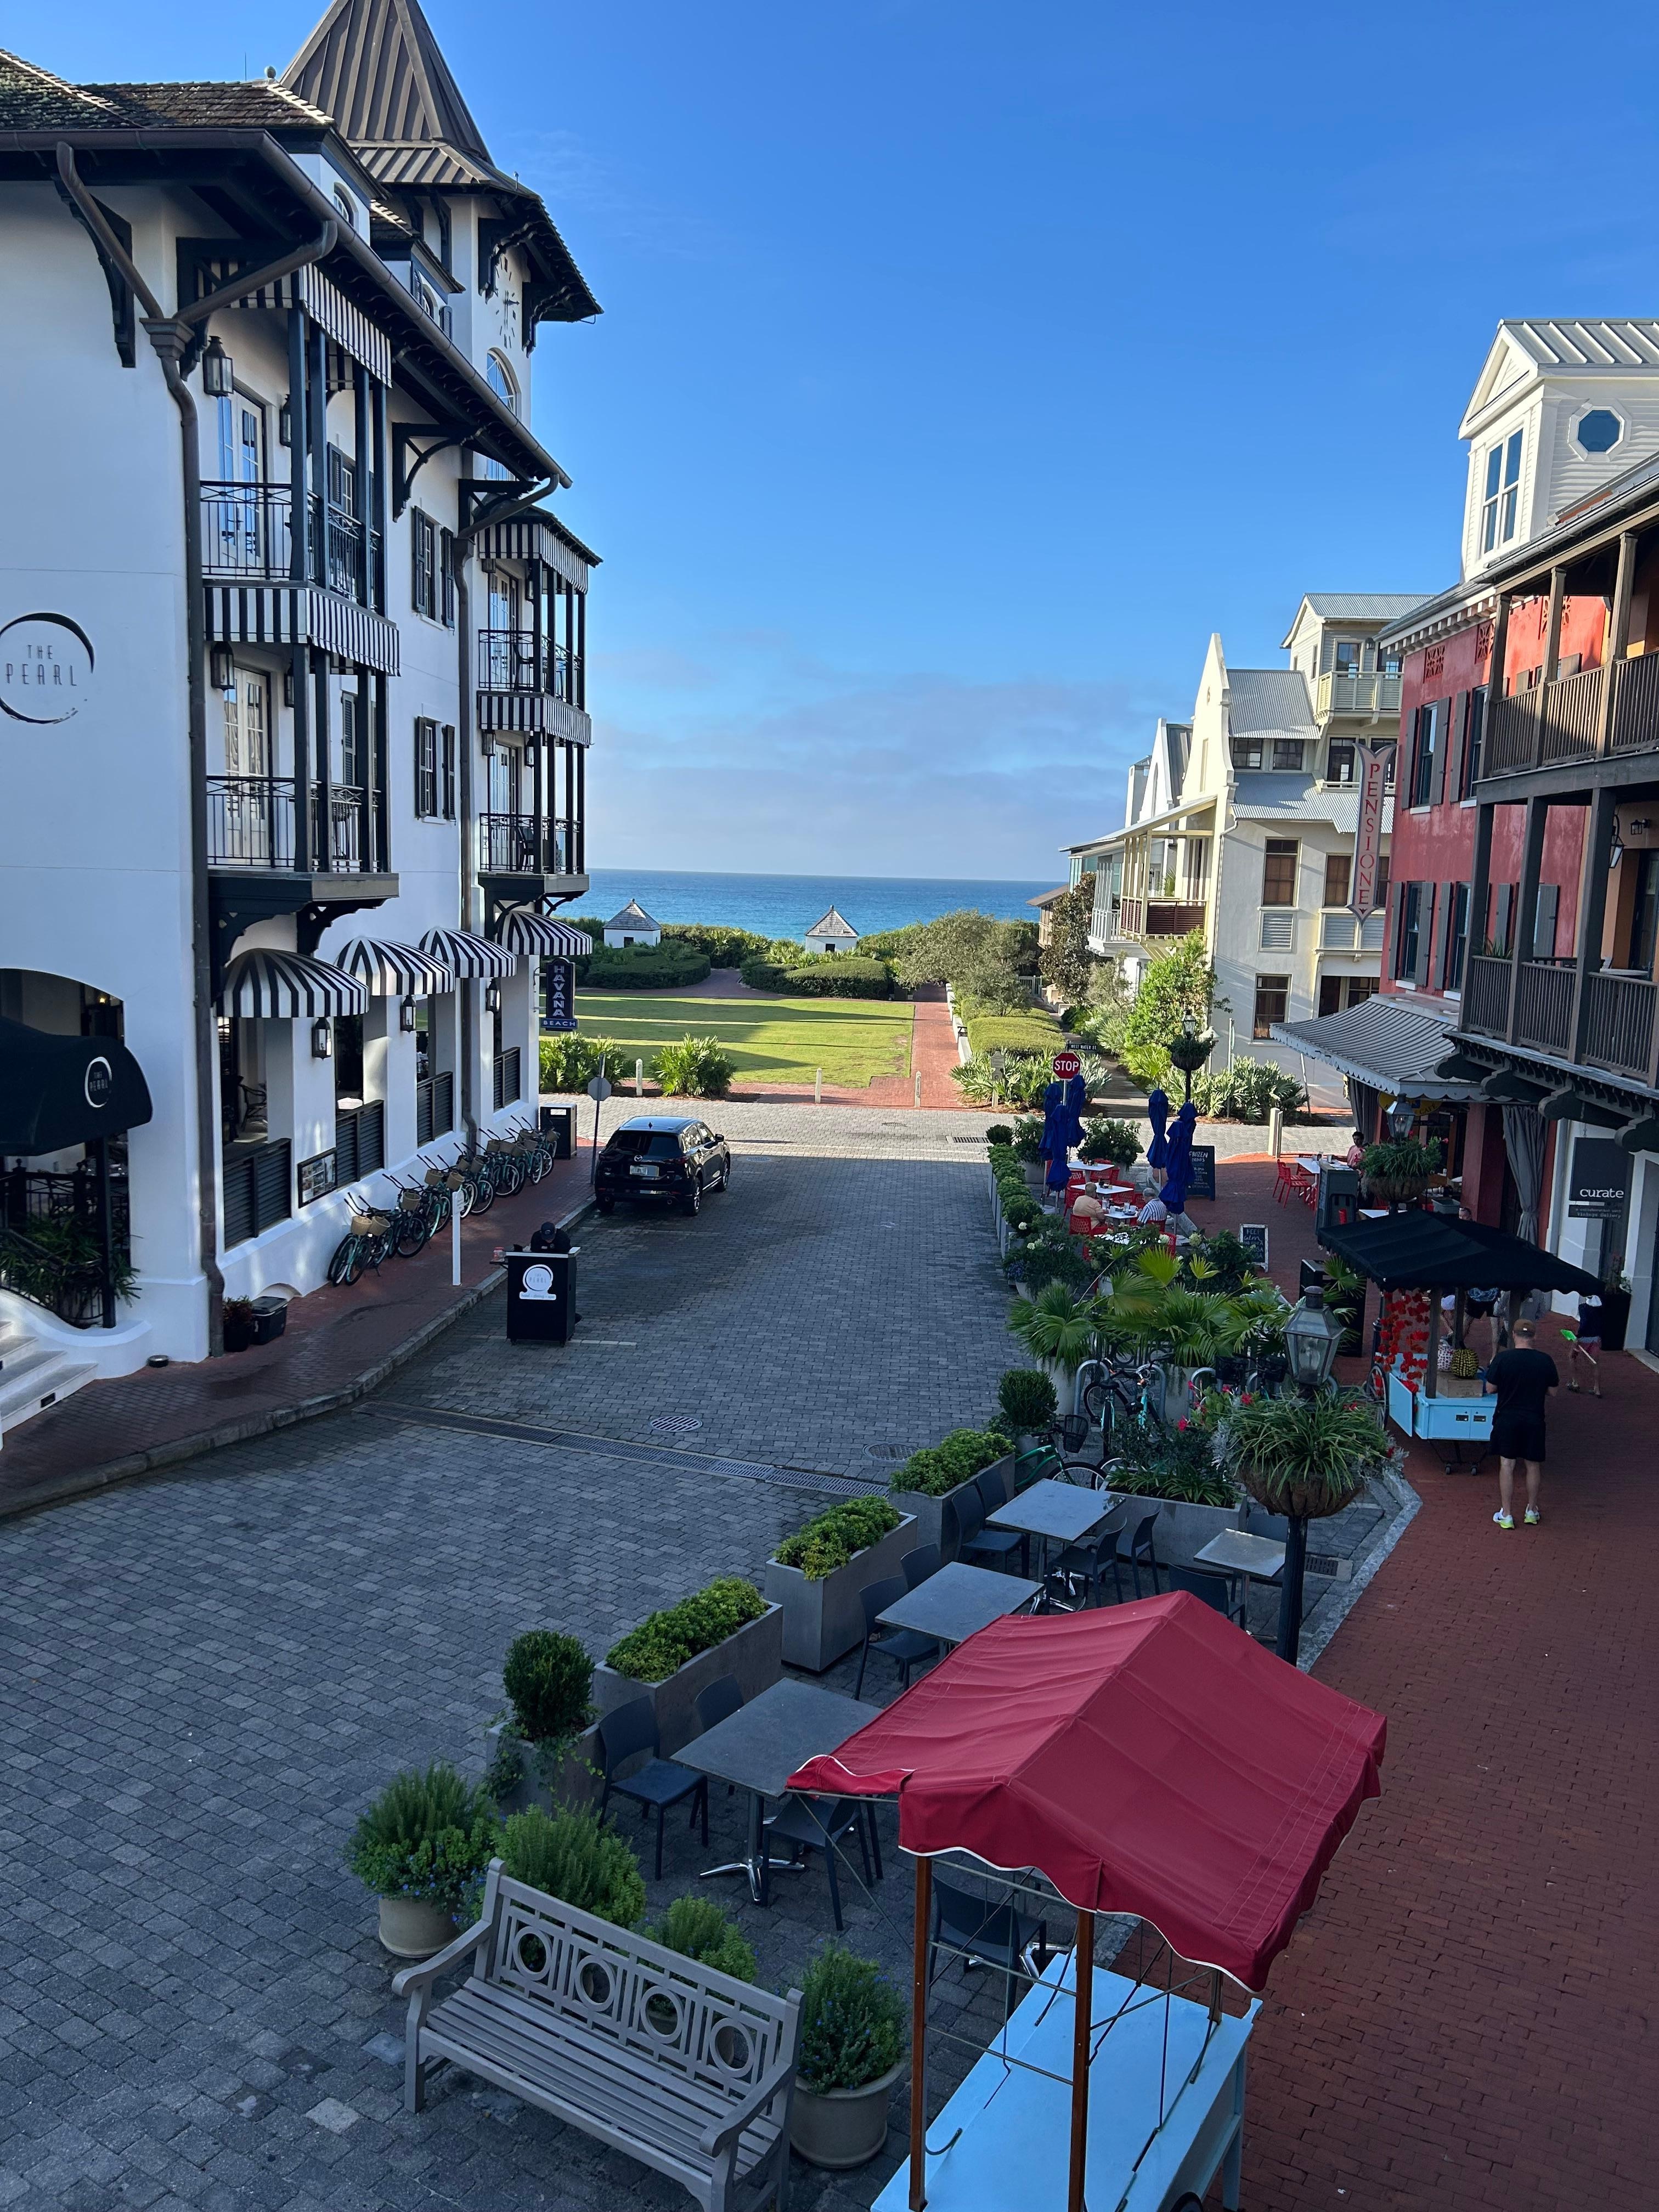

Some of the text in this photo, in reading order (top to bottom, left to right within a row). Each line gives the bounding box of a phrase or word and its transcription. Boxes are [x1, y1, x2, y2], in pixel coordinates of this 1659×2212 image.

[27, 645, 53, 659] THE
[6, 663, 77, 686] PEARL
[1359, 763, 1380, 905] PENSIONE
[553, 966, 566, 1017] HAVANA
[1054, 1060, 1079, 1071] STOP
[1580, 1188, 1624, 1198] curate
